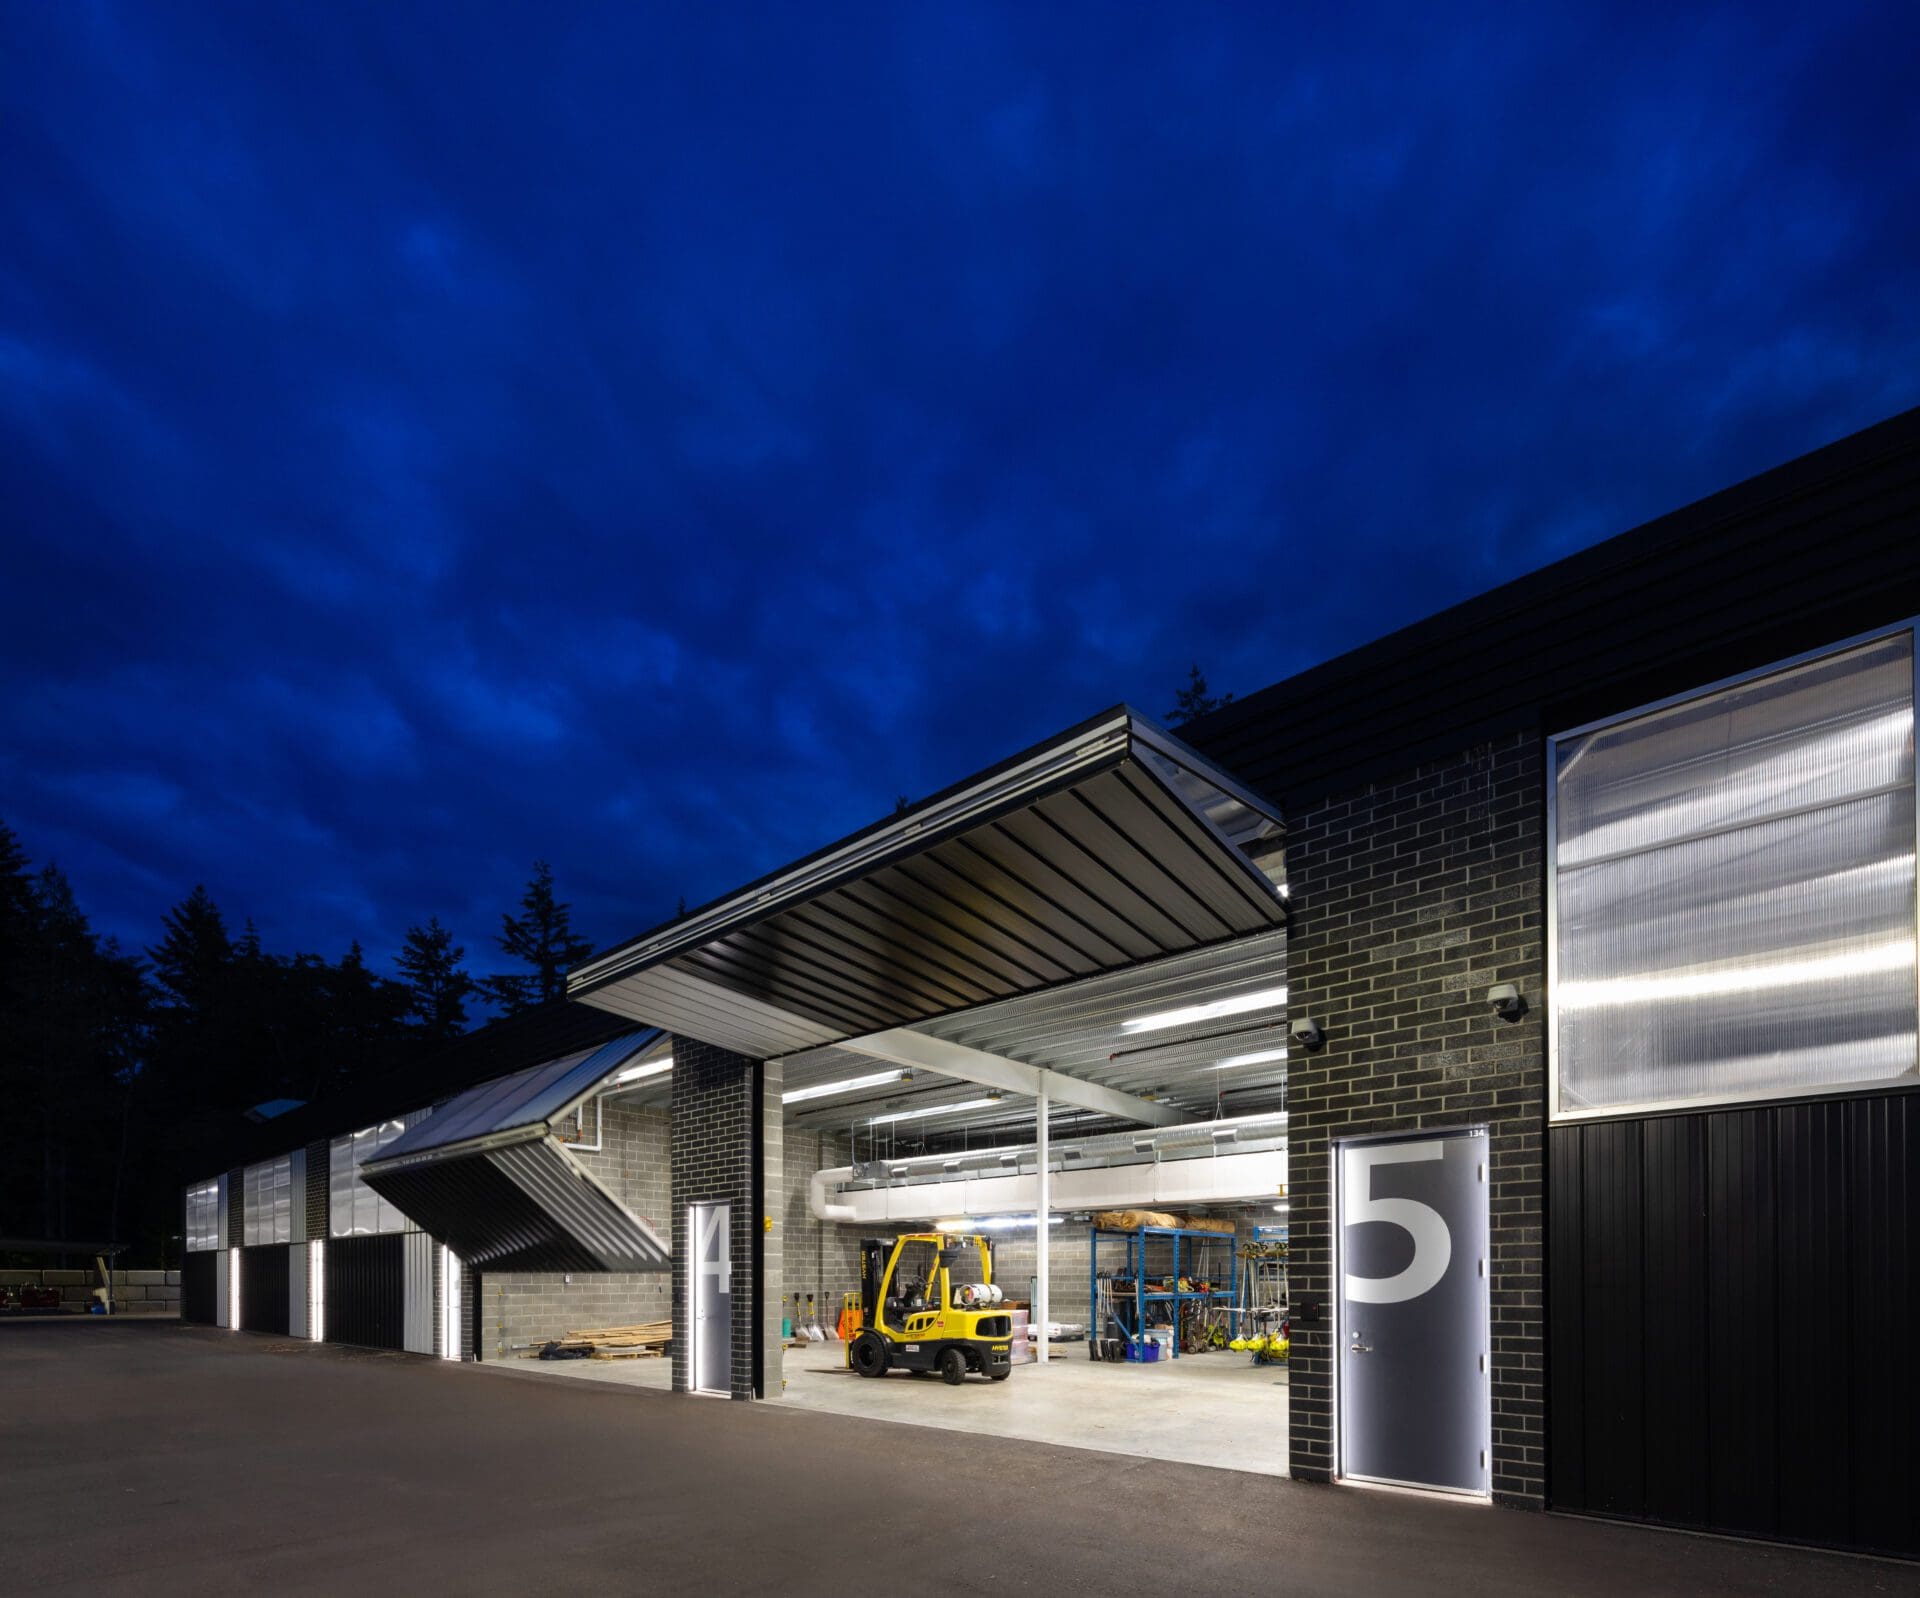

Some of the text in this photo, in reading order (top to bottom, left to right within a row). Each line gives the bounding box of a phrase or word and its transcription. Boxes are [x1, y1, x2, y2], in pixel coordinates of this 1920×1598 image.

[1469, 1129, 1485, 1138] 134
[699, 1205, 732, 1293] 4
[1344, 1140, 1452, 1304] 5
